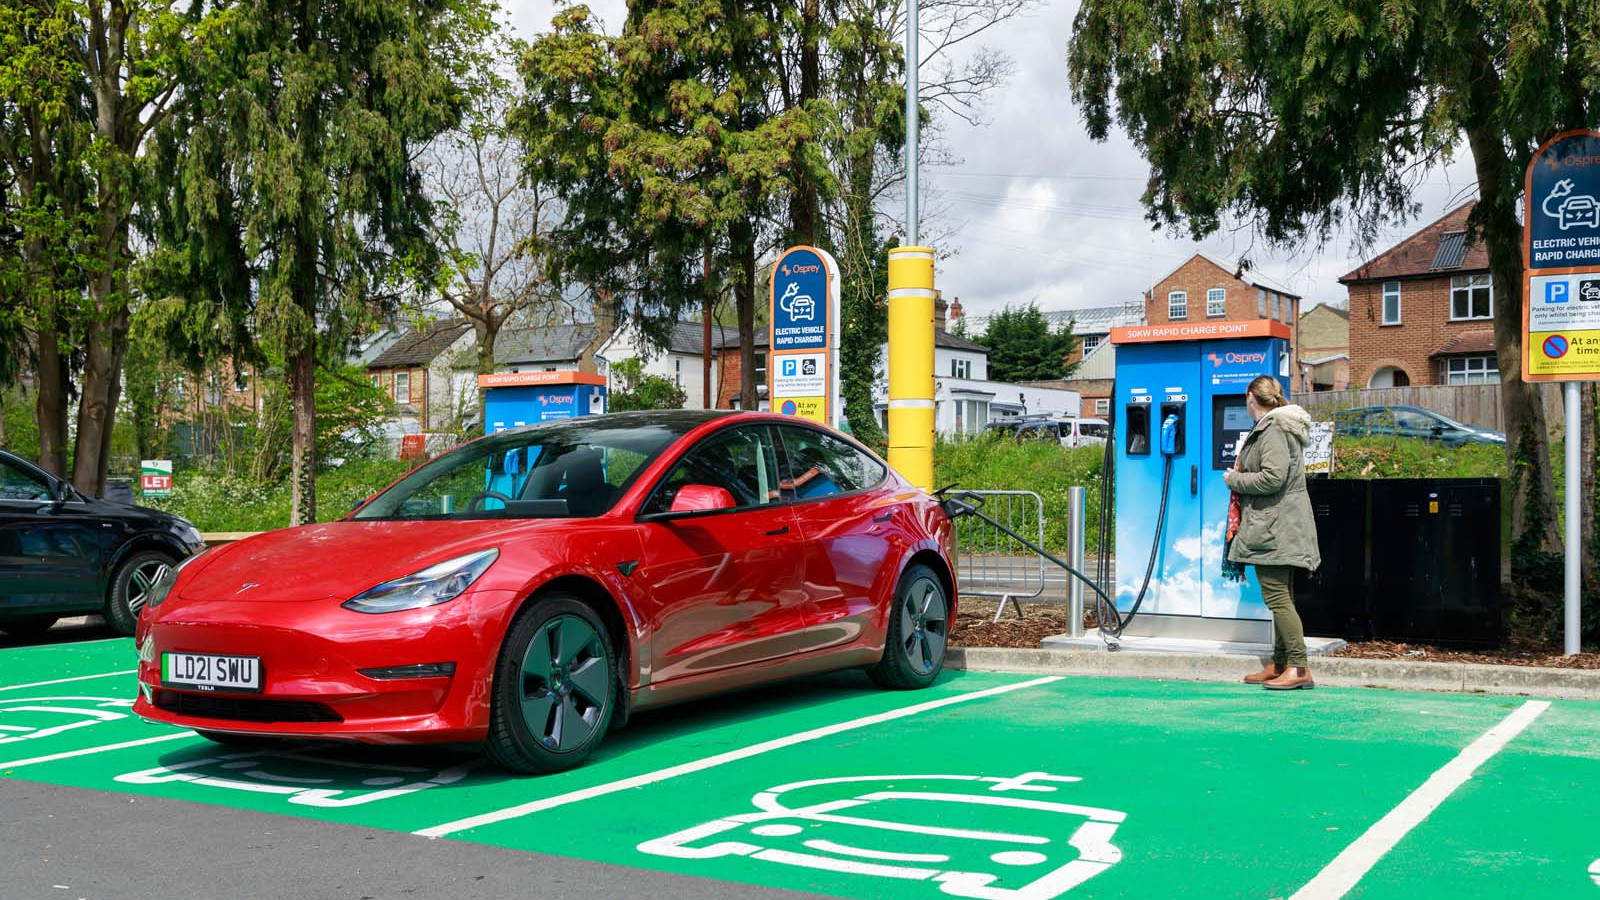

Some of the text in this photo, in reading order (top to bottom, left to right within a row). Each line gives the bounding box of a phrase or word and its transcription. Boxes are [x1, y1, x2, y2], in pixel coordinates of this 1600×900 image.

[1533, 236, 1600, 249] ELECTRIC VEHI
[1535, 250, 1563, 261] RAPID
[793, 264, 820, 274] Osprey
[1551, 284, 1565, 301] P
[1532, 305, 1555, 313] Parking
[775, 326, 824, 335] ELECTRIC VEHICLE
[1127, 324, 1248, 338] 50KW RAPID CHARGE POINT
[794, 335, 823, 343] CHARGING
[1571, 337, 1583, 345] At
[1225, 352, 1266, 364] Osprey
[785, 361, 794, 375] P
[549, 394, 574, 404] Osprey
[1305, 451, 1331, 459] COLD
[144, 476, 170, 488] LET
[175, 655, 252, 683] LD21 SWU
